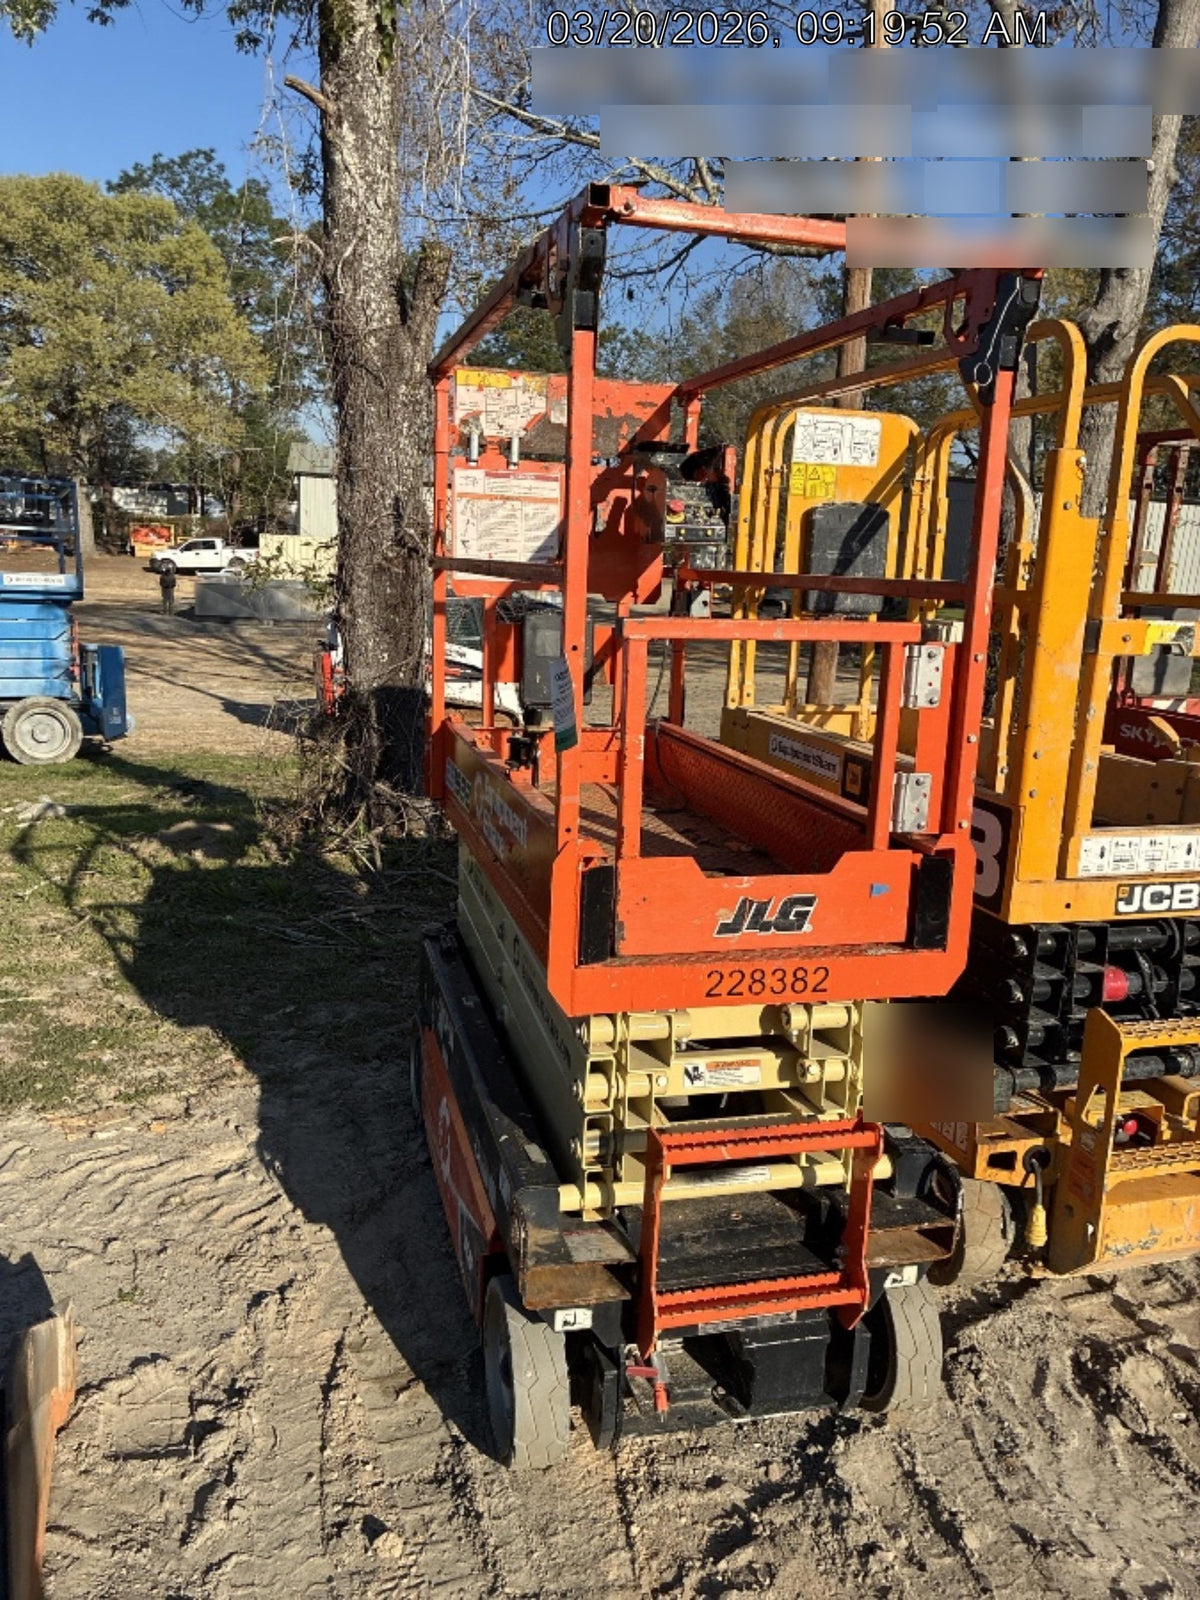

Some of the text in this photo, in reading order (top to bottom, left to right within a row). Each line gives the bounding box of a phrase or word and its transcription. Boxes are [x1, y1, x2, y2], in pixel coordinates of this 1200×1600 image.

[1116, 883, 1200, 913] JCB
[713, 893, 819, 938] JLG
[704, 965, 830, 998] 228382
